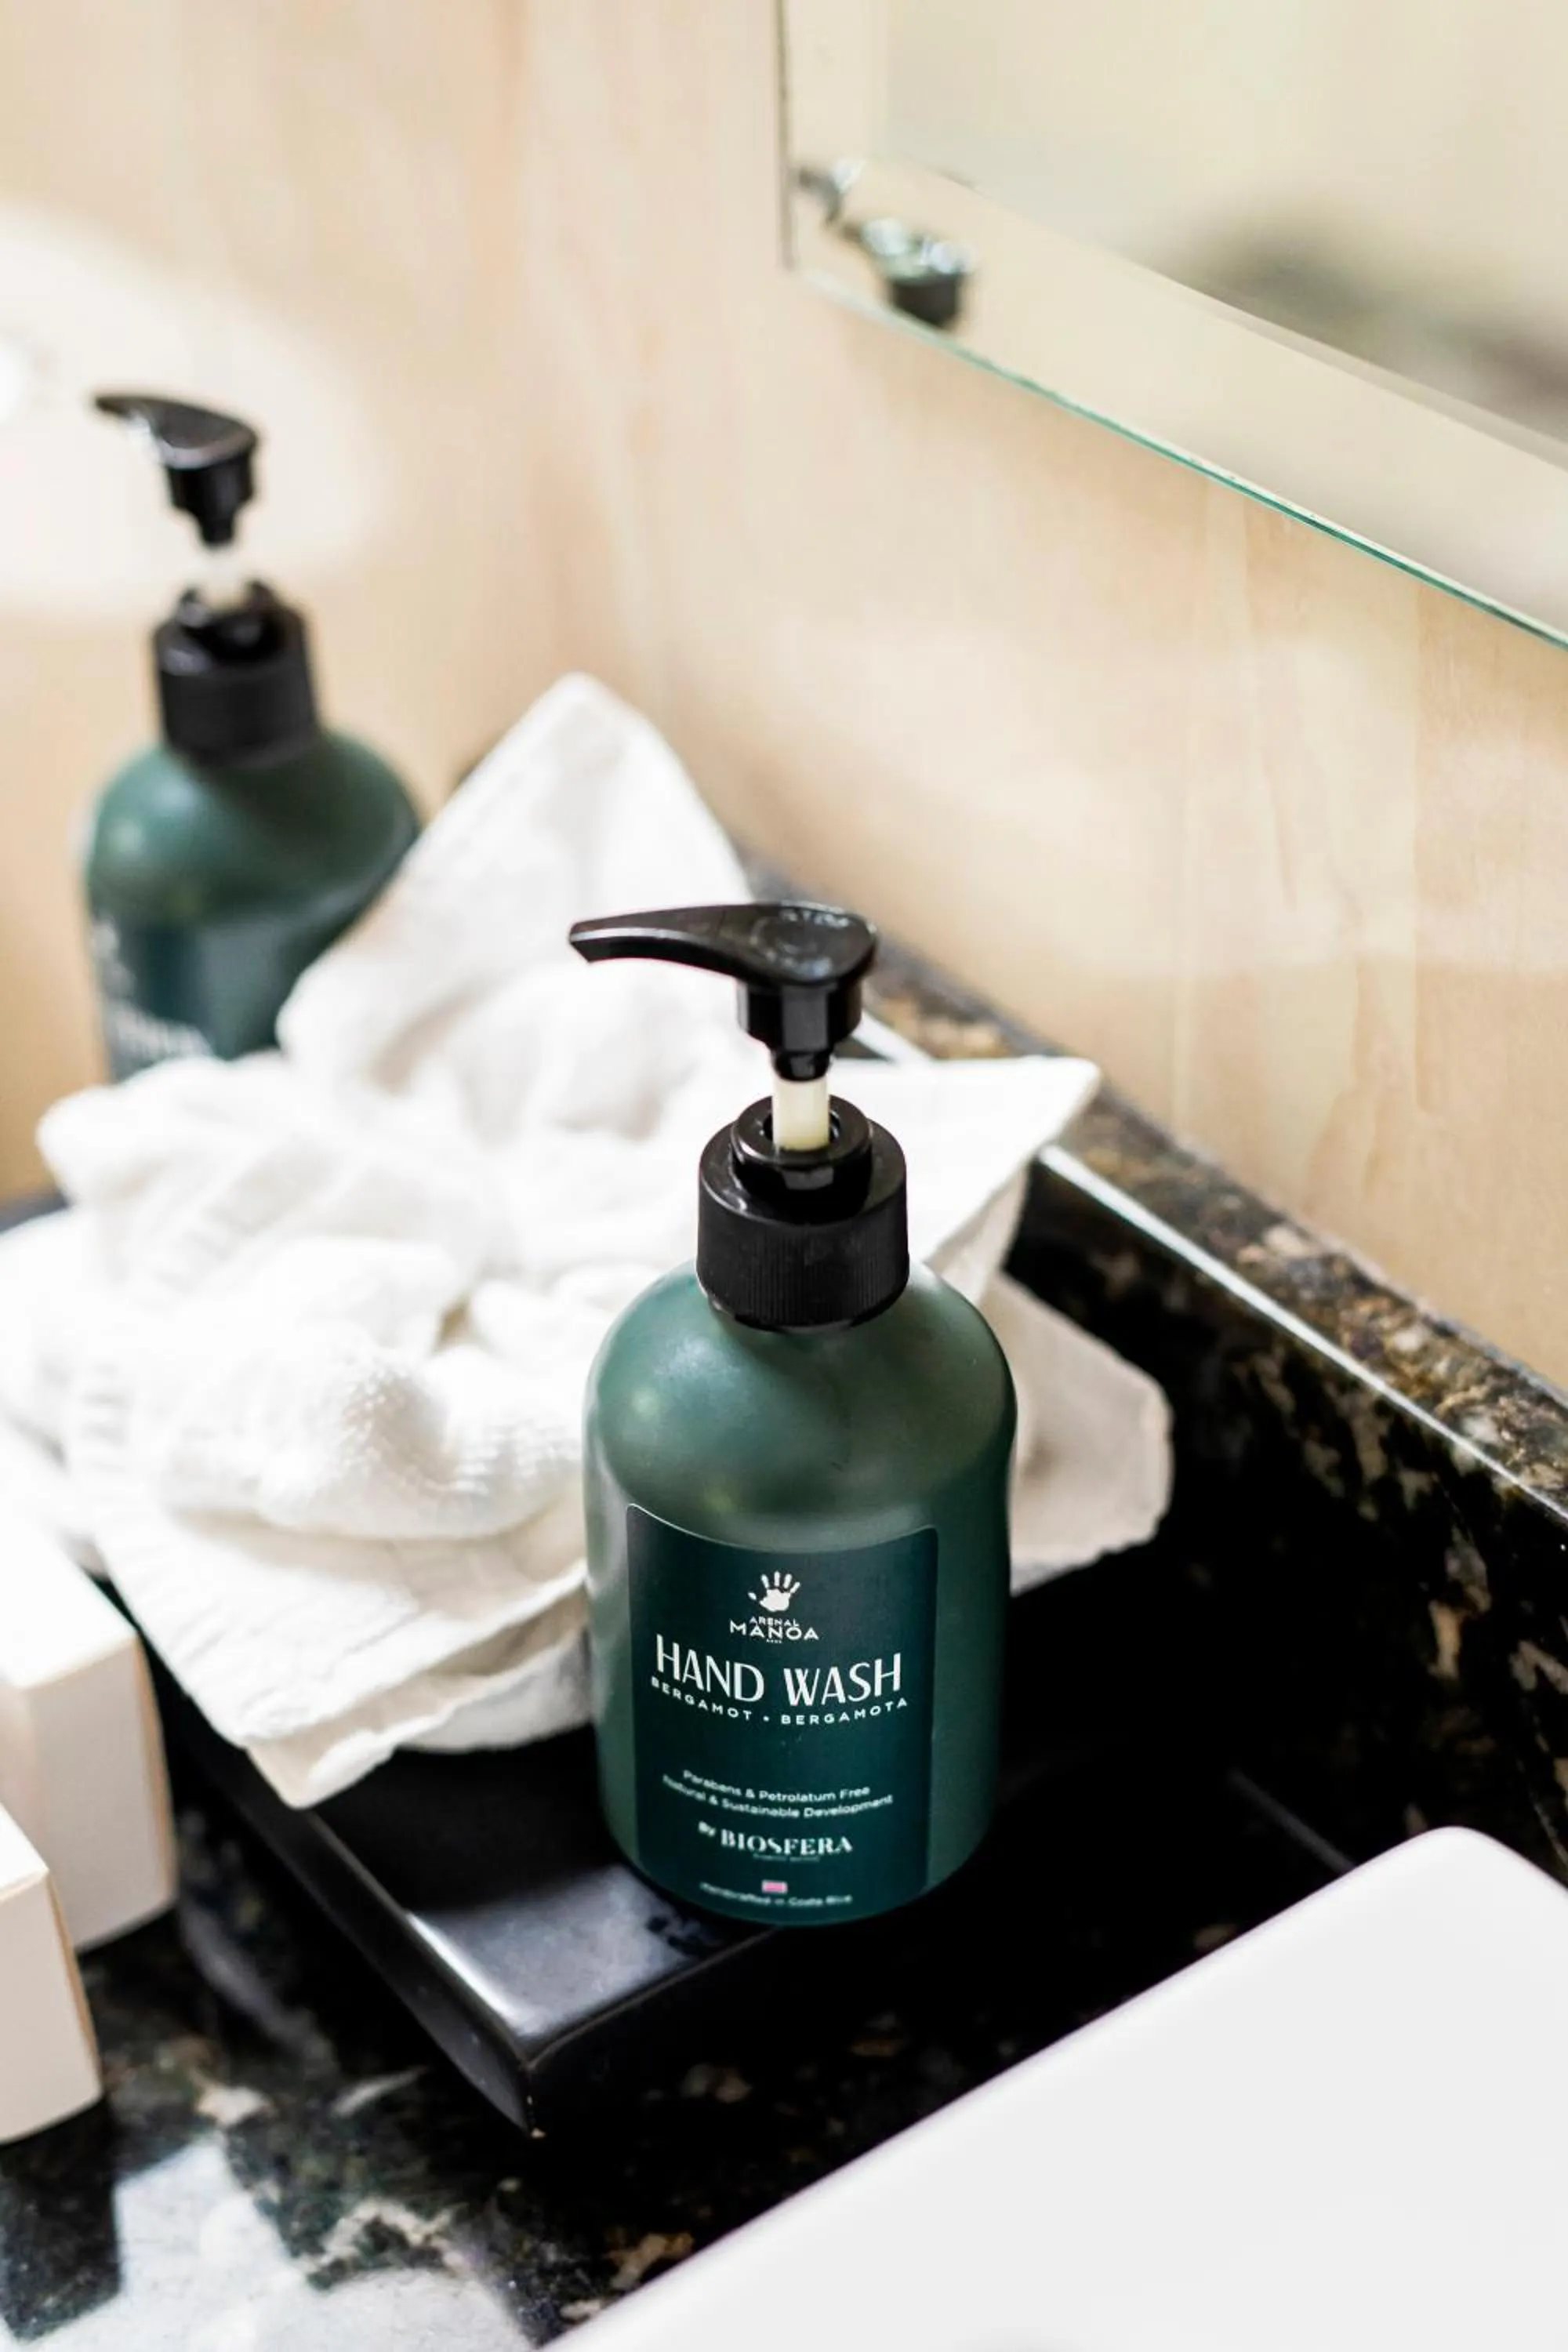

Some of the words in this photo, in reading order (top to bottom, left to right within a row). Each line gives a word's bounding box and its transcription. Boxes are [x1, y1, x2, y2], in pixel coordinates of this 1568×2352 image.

[730, 1619, 819, 1641] MANOA
[750, 1616, 800, 1627] ARENAL
[656, 1633, 765, 1703] HAND
[783, 1652, 902, 1708] WASH
[651, 1675, 753, 1722] BERGAMOT
[781, 1697, 909, 1726] BERGAMOTA
[683, 1769, 742, 1796] Parabens
[745, 1788, 755, 1799] &
[758, 1790, 837, 1802] Petrolatum
[840, 1786, 870, 1799] Free
[721, 1798, 800, 1818] Sustainable
[804, 1795, 894, 1819] Development
[720, 1828, 853, 1856] BIOSFERA
